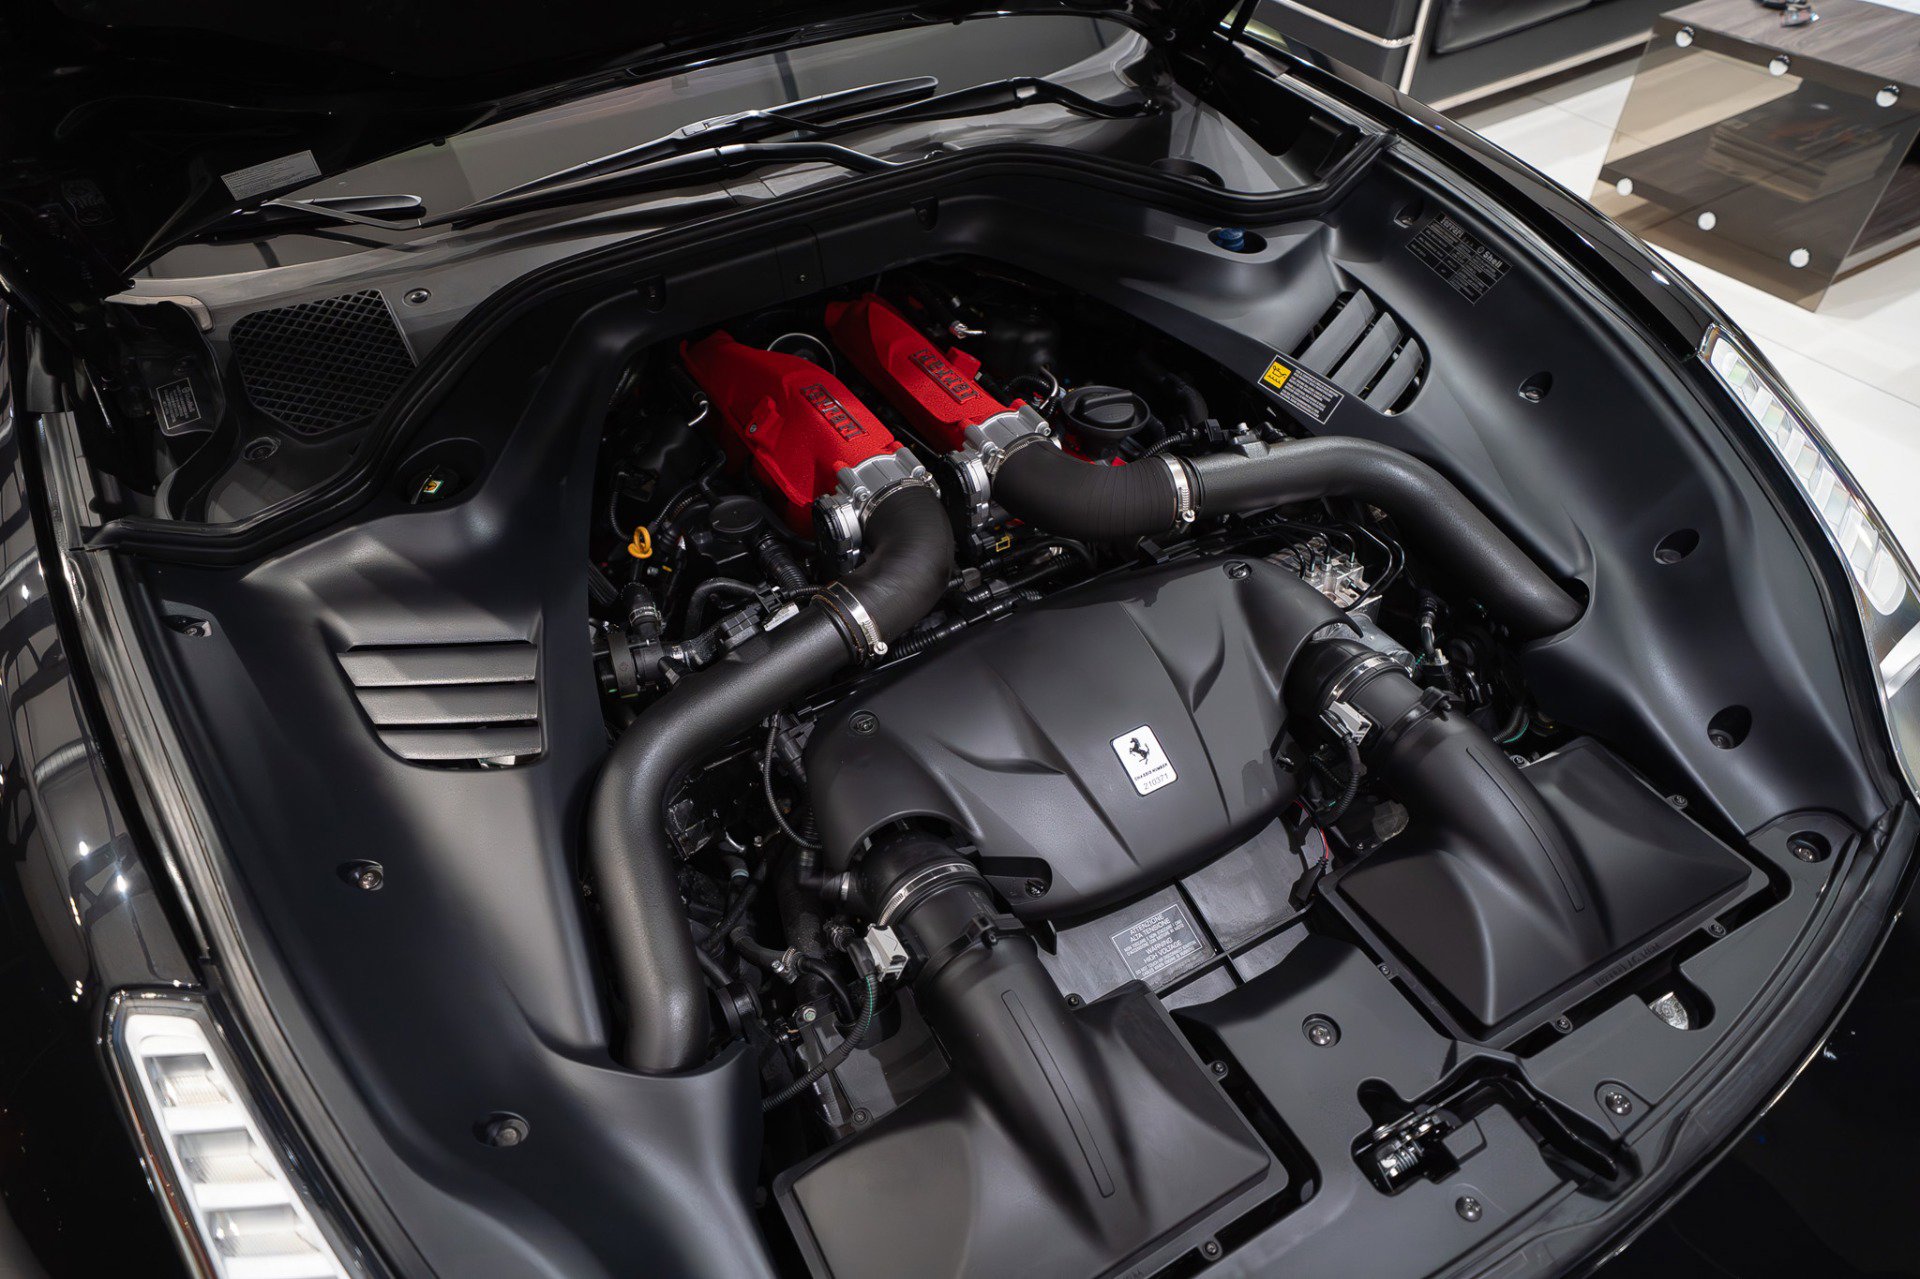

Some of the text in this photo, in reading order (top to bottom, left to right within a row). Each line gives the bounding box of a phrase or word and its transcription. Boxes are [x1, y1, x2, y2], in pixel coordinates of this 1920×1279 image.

[1483, 250, 1503, 269] Shell
[1129, 913, 1164, 936] ATTENZIONE
[1129, 931, 1143, 943] ALTA
[1142, 917, 1171, 936] TENSIONE
[1143, 952, 1159, 964] HIGH
[1157, 939, 1182, 956] VOLTAGE
[1145, 936, 1173, 955] WARNING
